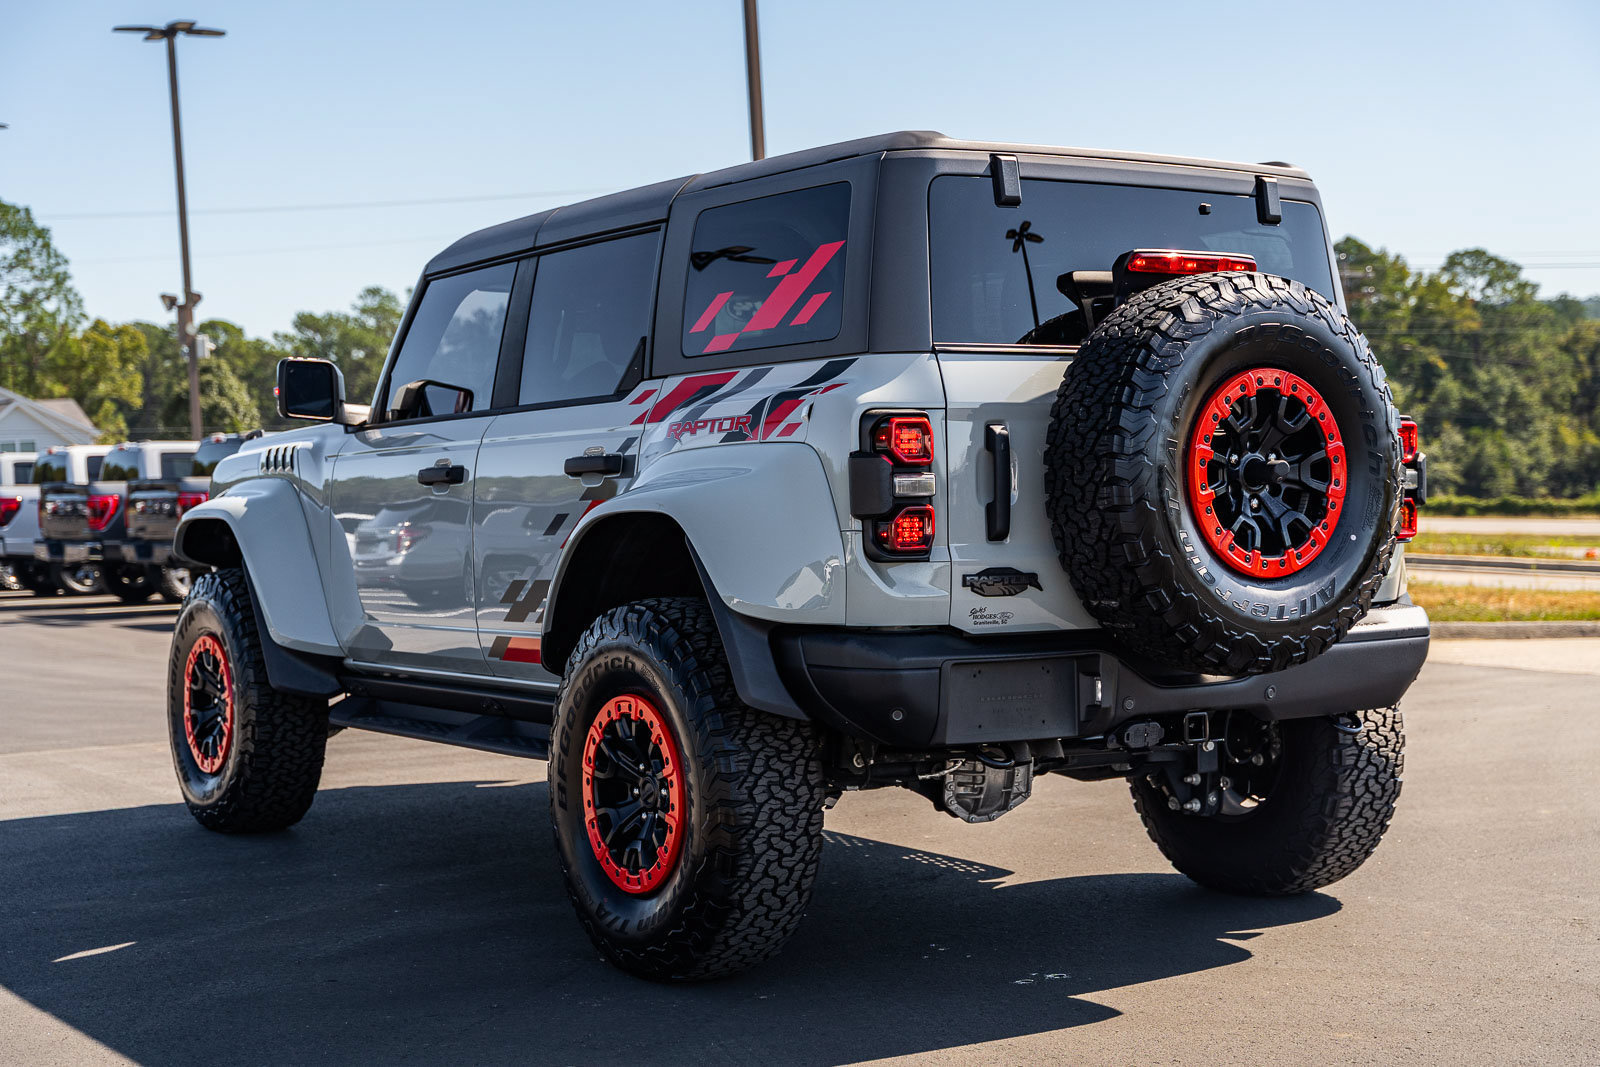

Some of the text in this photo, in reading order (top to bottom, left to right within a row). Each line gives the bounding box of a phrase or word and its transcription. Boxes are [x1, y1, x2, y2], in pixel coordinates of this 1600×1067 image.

[666, 413, 754, 446] RAPTOR
[1233, 322, 1384, 476] BFGoodrich
[1178, 528, 1337, 622] All-Terrain
[557, 655, 637, 812] BFGoodrich
